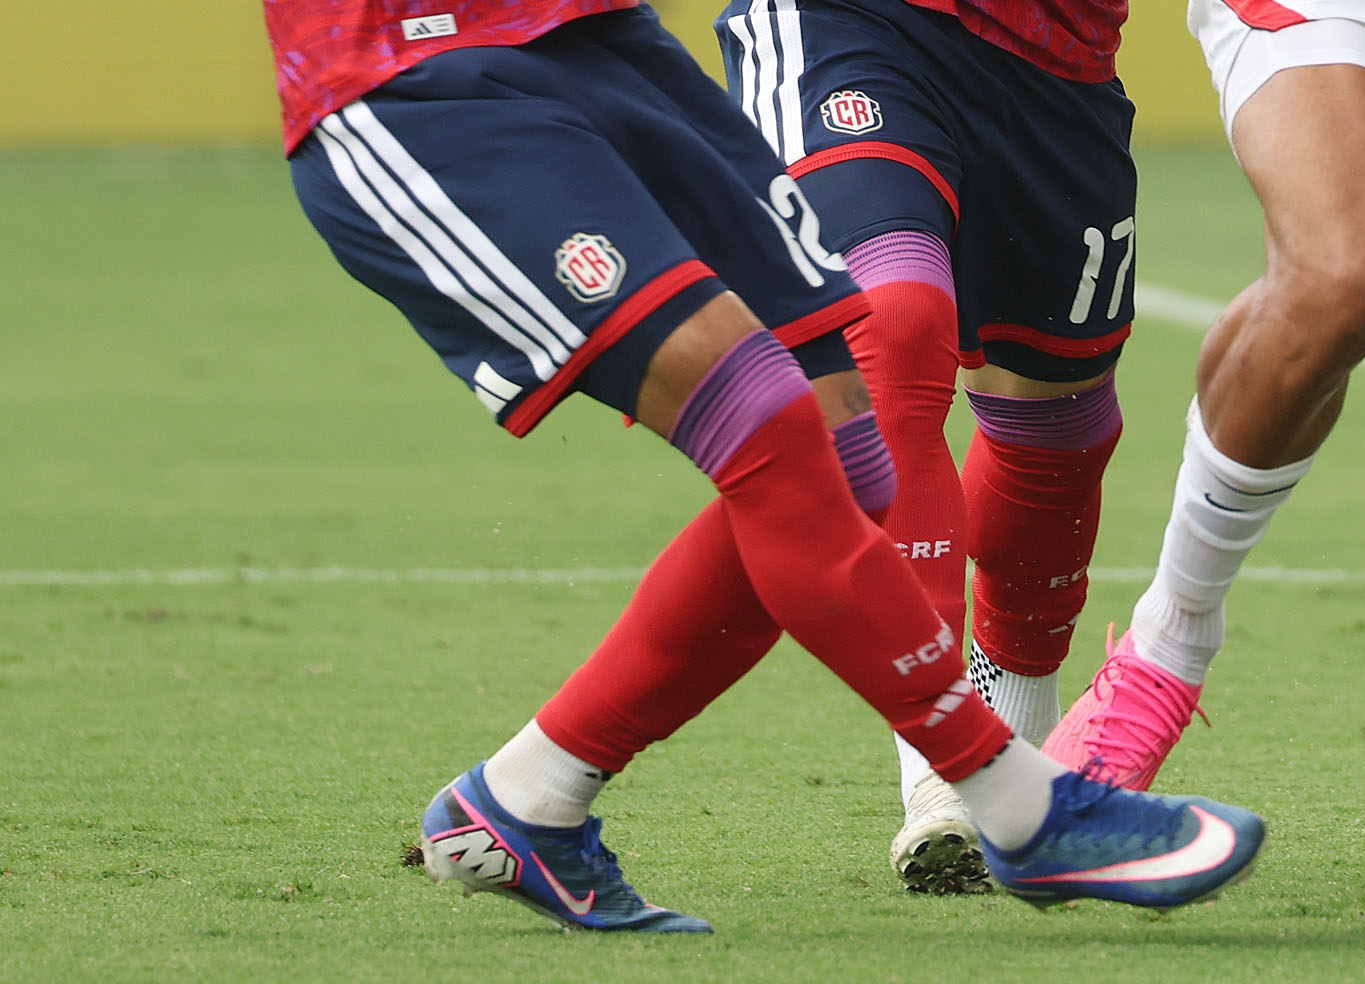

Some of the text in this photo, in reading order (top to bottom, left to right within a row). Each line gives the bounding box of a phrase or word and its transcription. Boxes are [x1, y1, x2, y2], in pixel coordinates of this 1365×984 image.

[834, 99, 870, 126] CR
[568, 245, 611, 288] CR
[755, 174, 848, 287] 12
[1069, 216, 1135, 324] 17
